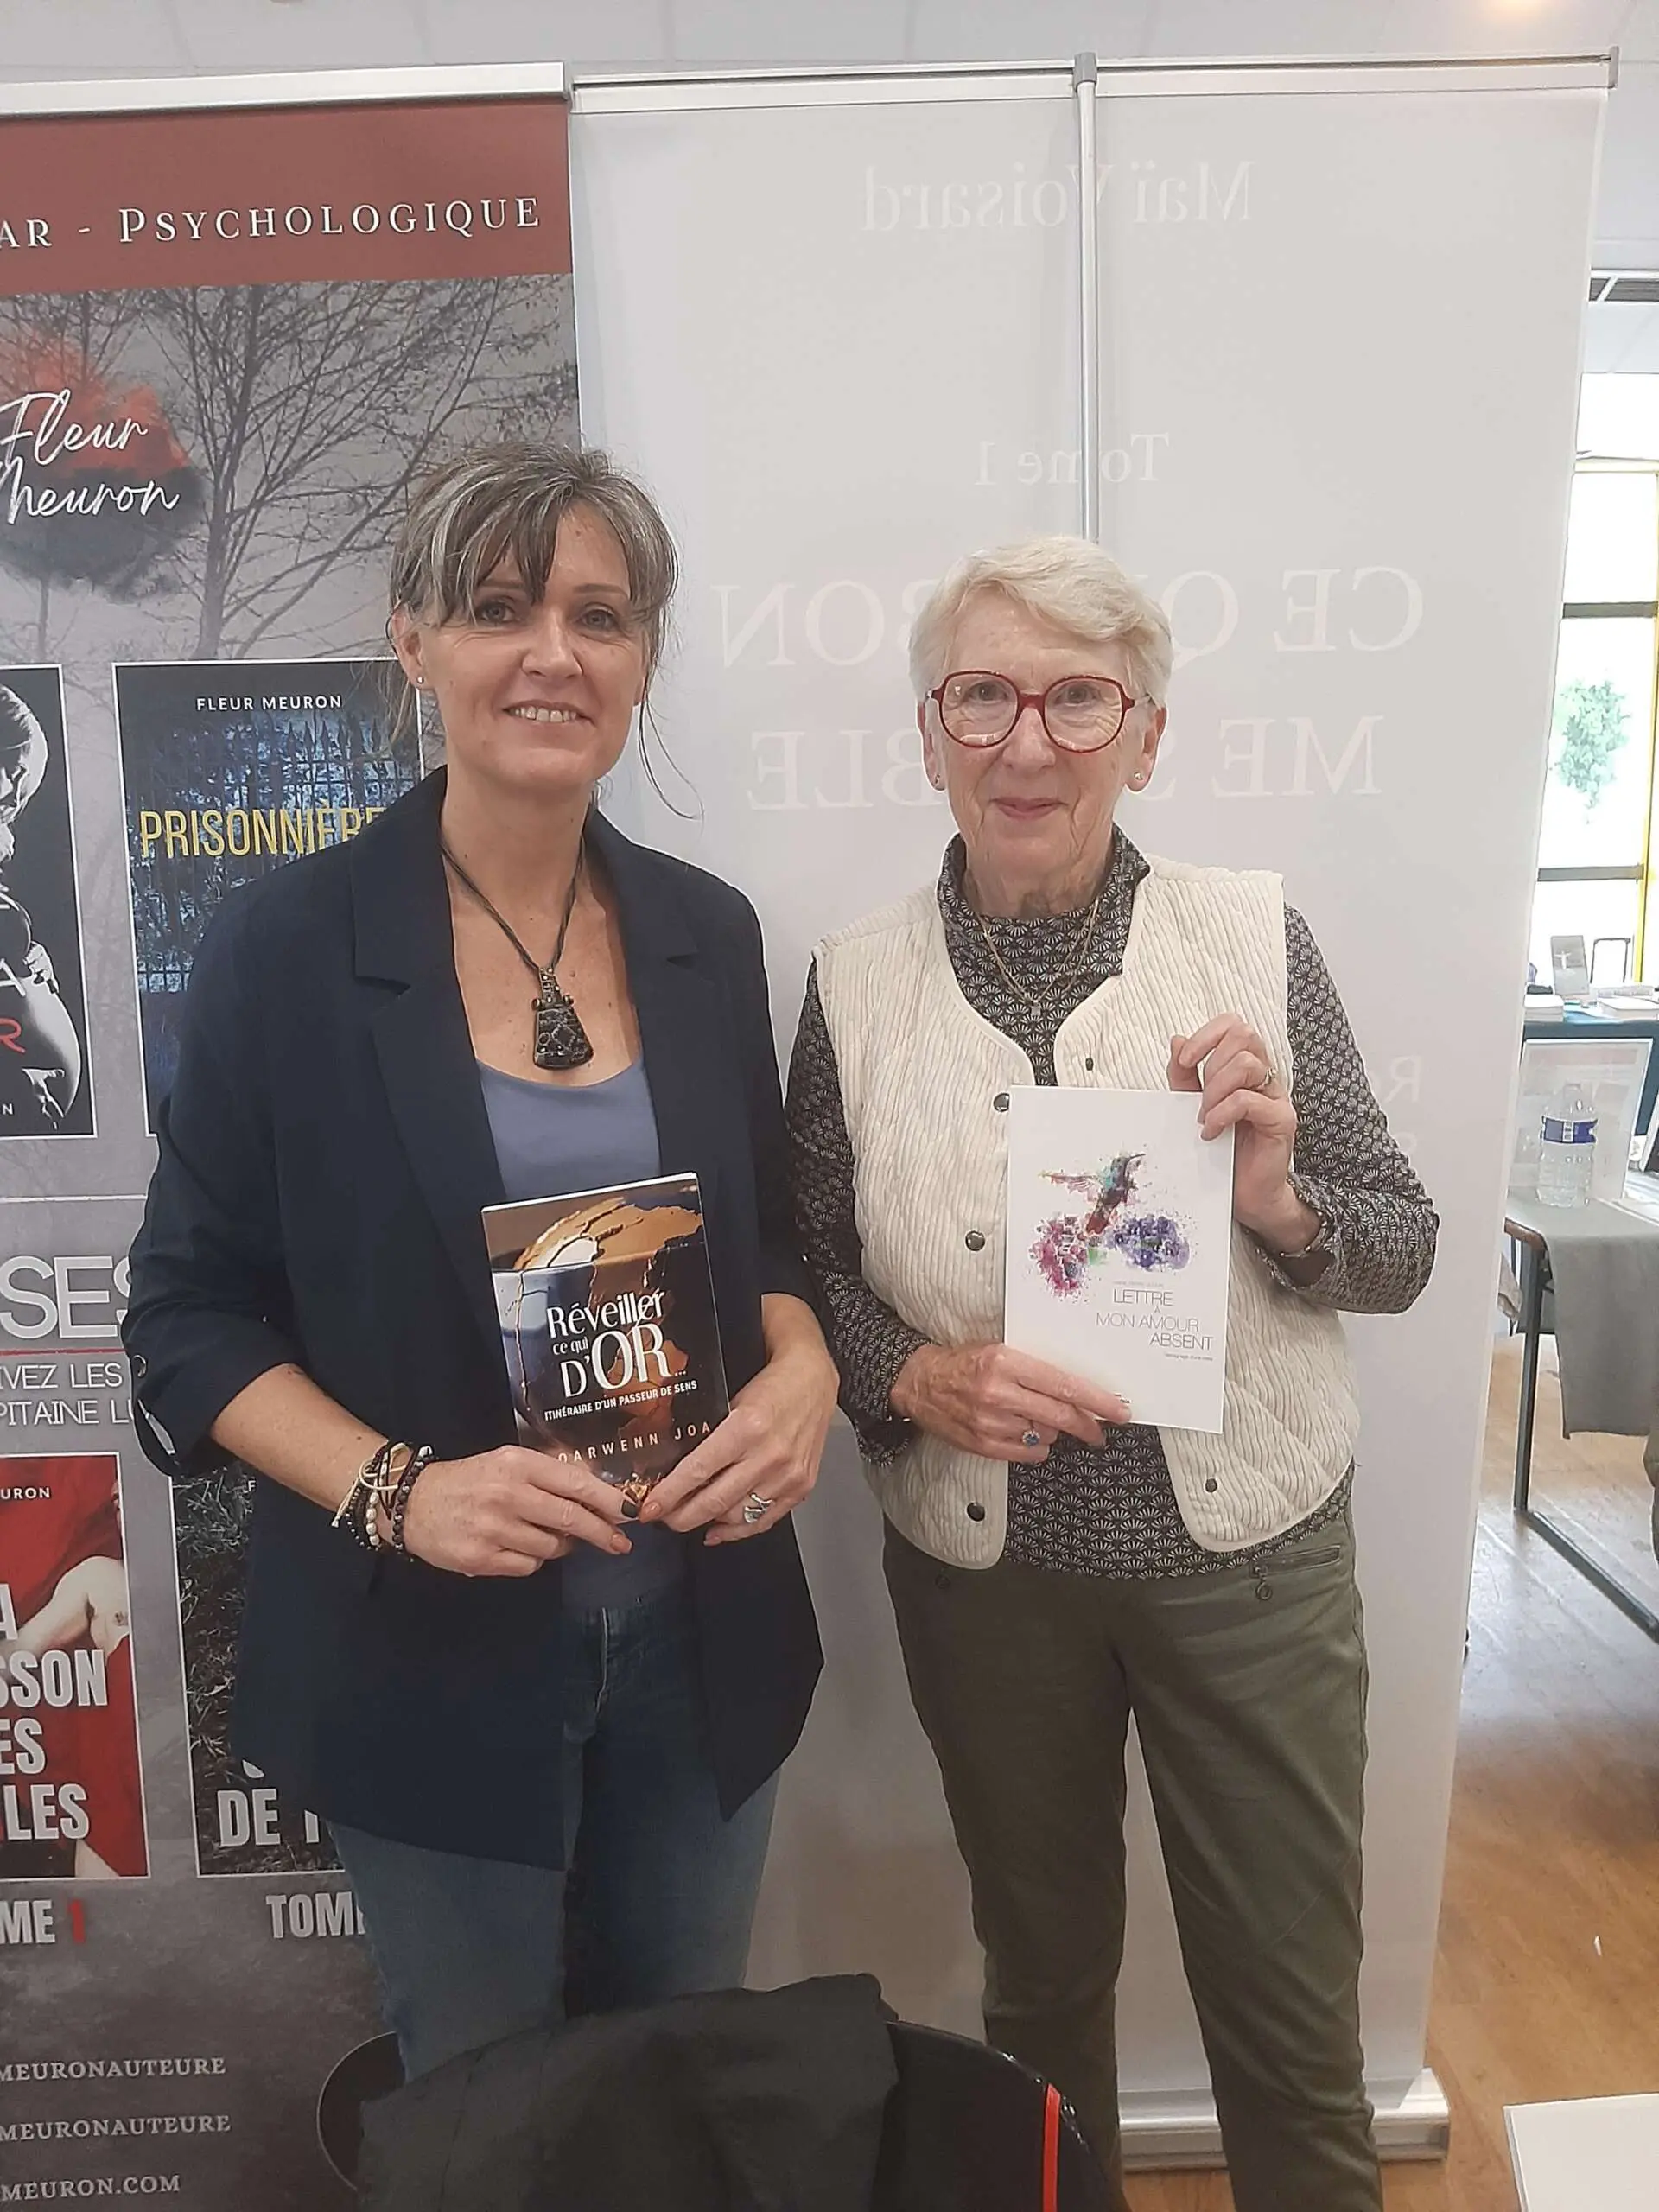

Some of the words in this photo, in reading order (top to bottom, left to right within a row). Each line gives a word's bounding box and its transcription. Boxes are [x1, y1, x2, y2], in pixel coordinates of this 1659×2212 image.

[118, 197, 540, 243] PSYCHOLOGIQUE
[0, 389, 148, 467] Fleur
[196, 697, 254, 711] FLEUR
[262, 695, 342, 710] MEURON
[1113, 1288, 1173, 1306] LETTRE
[547, 1288, 664, 1339] Réveiller
[1096, 1313, 1135, 1327] MON
[1139, 1316, 1199, 1332] AMOUR
[1150, 1332, 1214, 1350] ABSENT
[69, 1363, 123, 1388] LES
[544, 1402, 593, 1421] ITINÉRAIRE
[619, 1388, 658, 1406] PASSEUR
[660, 1384, 672, 1397] DE
[674, 1380, 697, 1394] SENS
